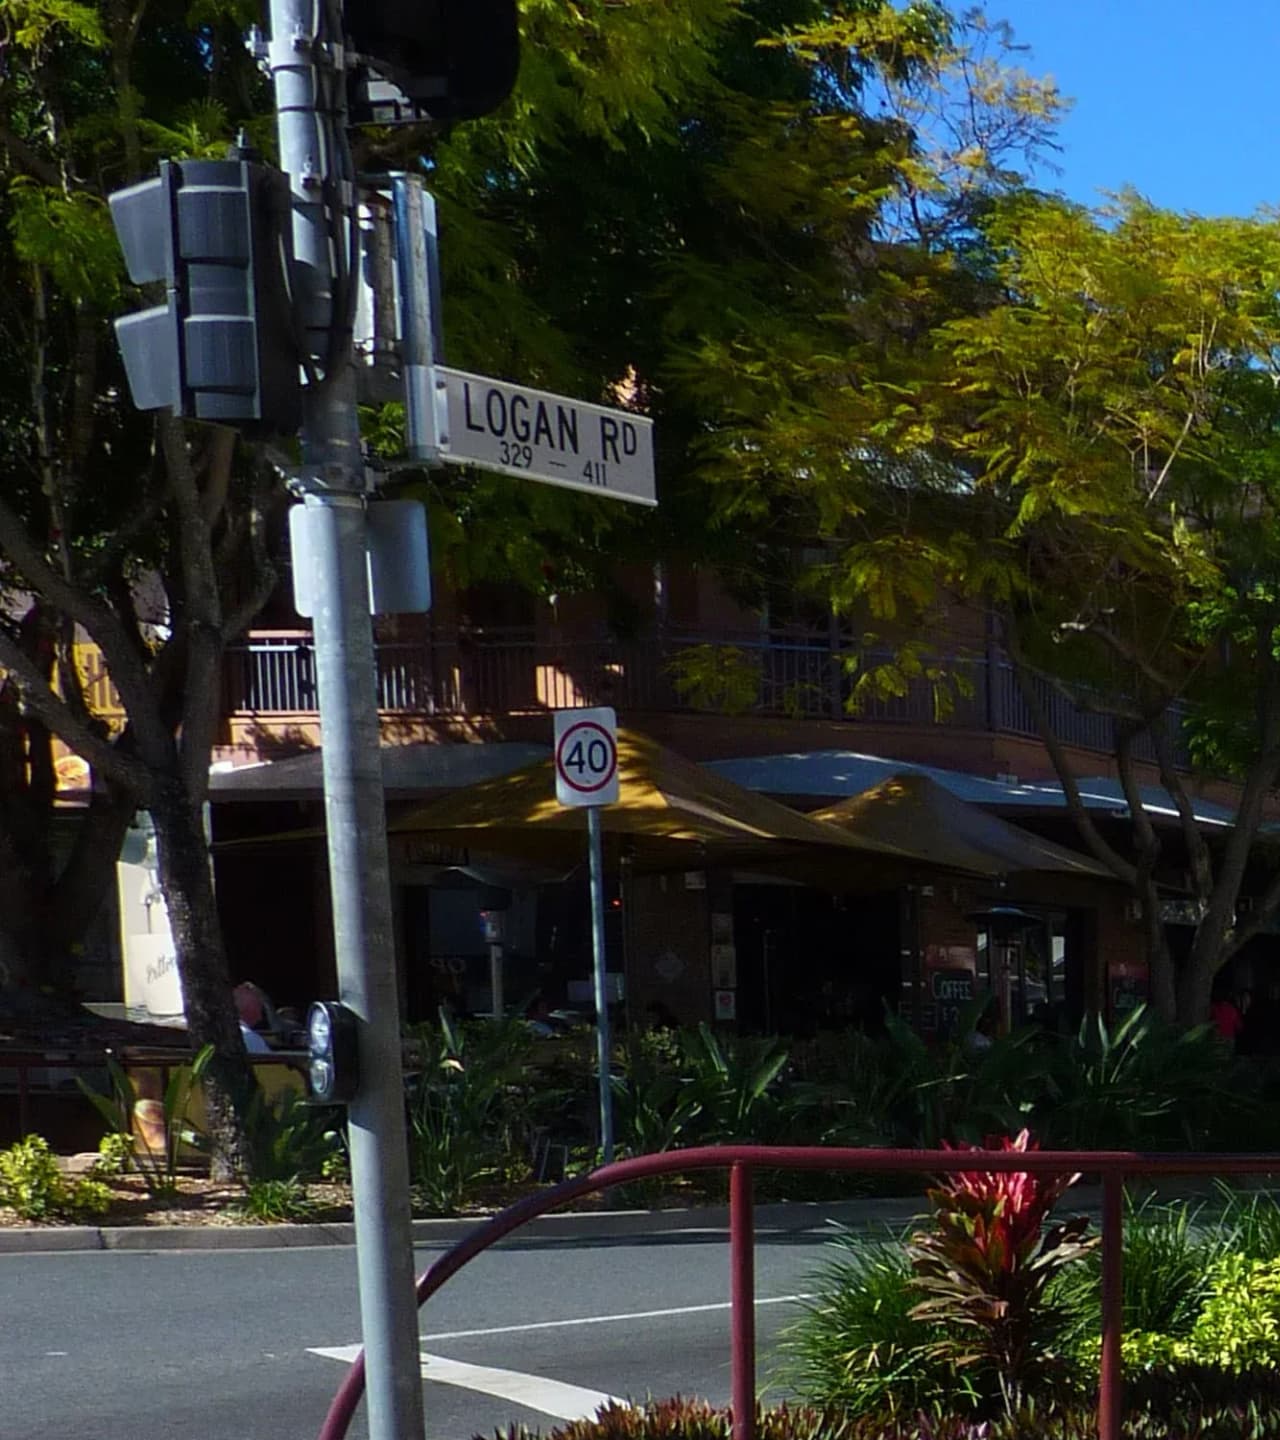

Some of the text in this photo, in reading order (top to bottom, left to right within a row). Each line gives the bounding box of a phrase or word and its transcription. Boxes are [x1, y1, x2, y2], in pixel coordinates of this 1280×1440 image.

[464, 383, 579, 454] LOGAN
[500, 441, 533, 468] 329
[583, 460, 607, 486] 411
[565, 740, 608, 774] 40
